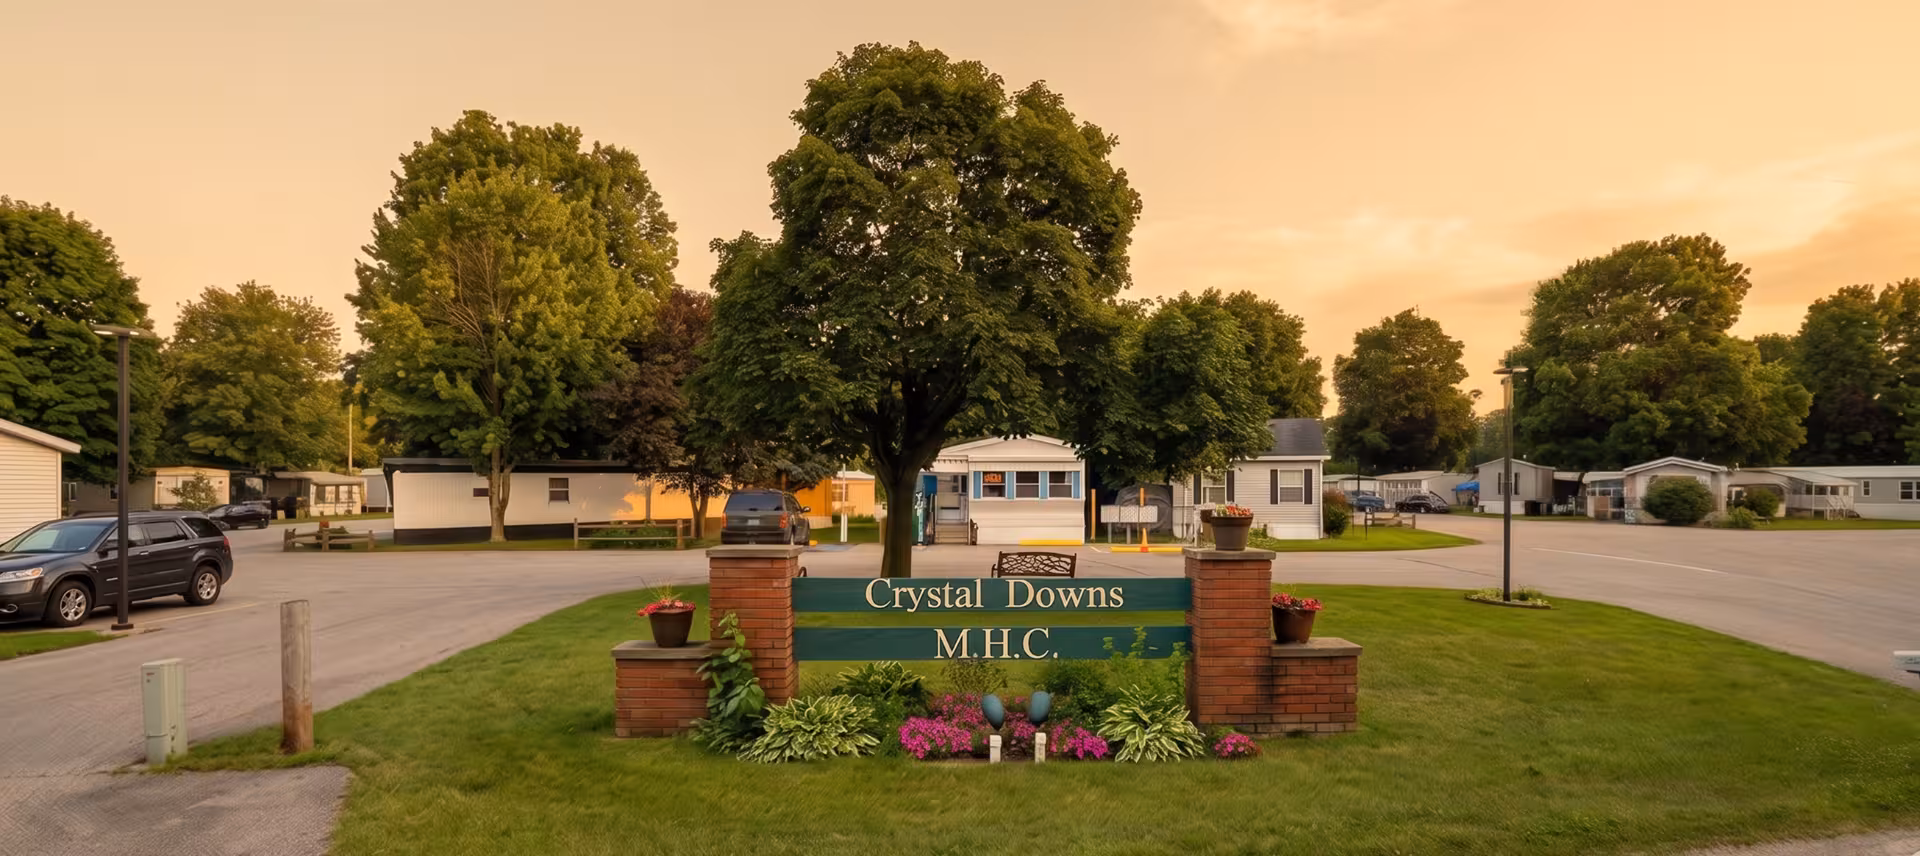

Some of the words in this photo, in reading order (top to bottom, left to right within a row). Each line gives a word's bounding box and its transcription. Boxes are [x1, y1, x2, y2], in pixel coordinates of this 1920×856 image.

[865, 578, 984, 612] Crystal
[1005, 579, 1124, 608] Downs
[933, 627, 1058, 659] M.H.C.
